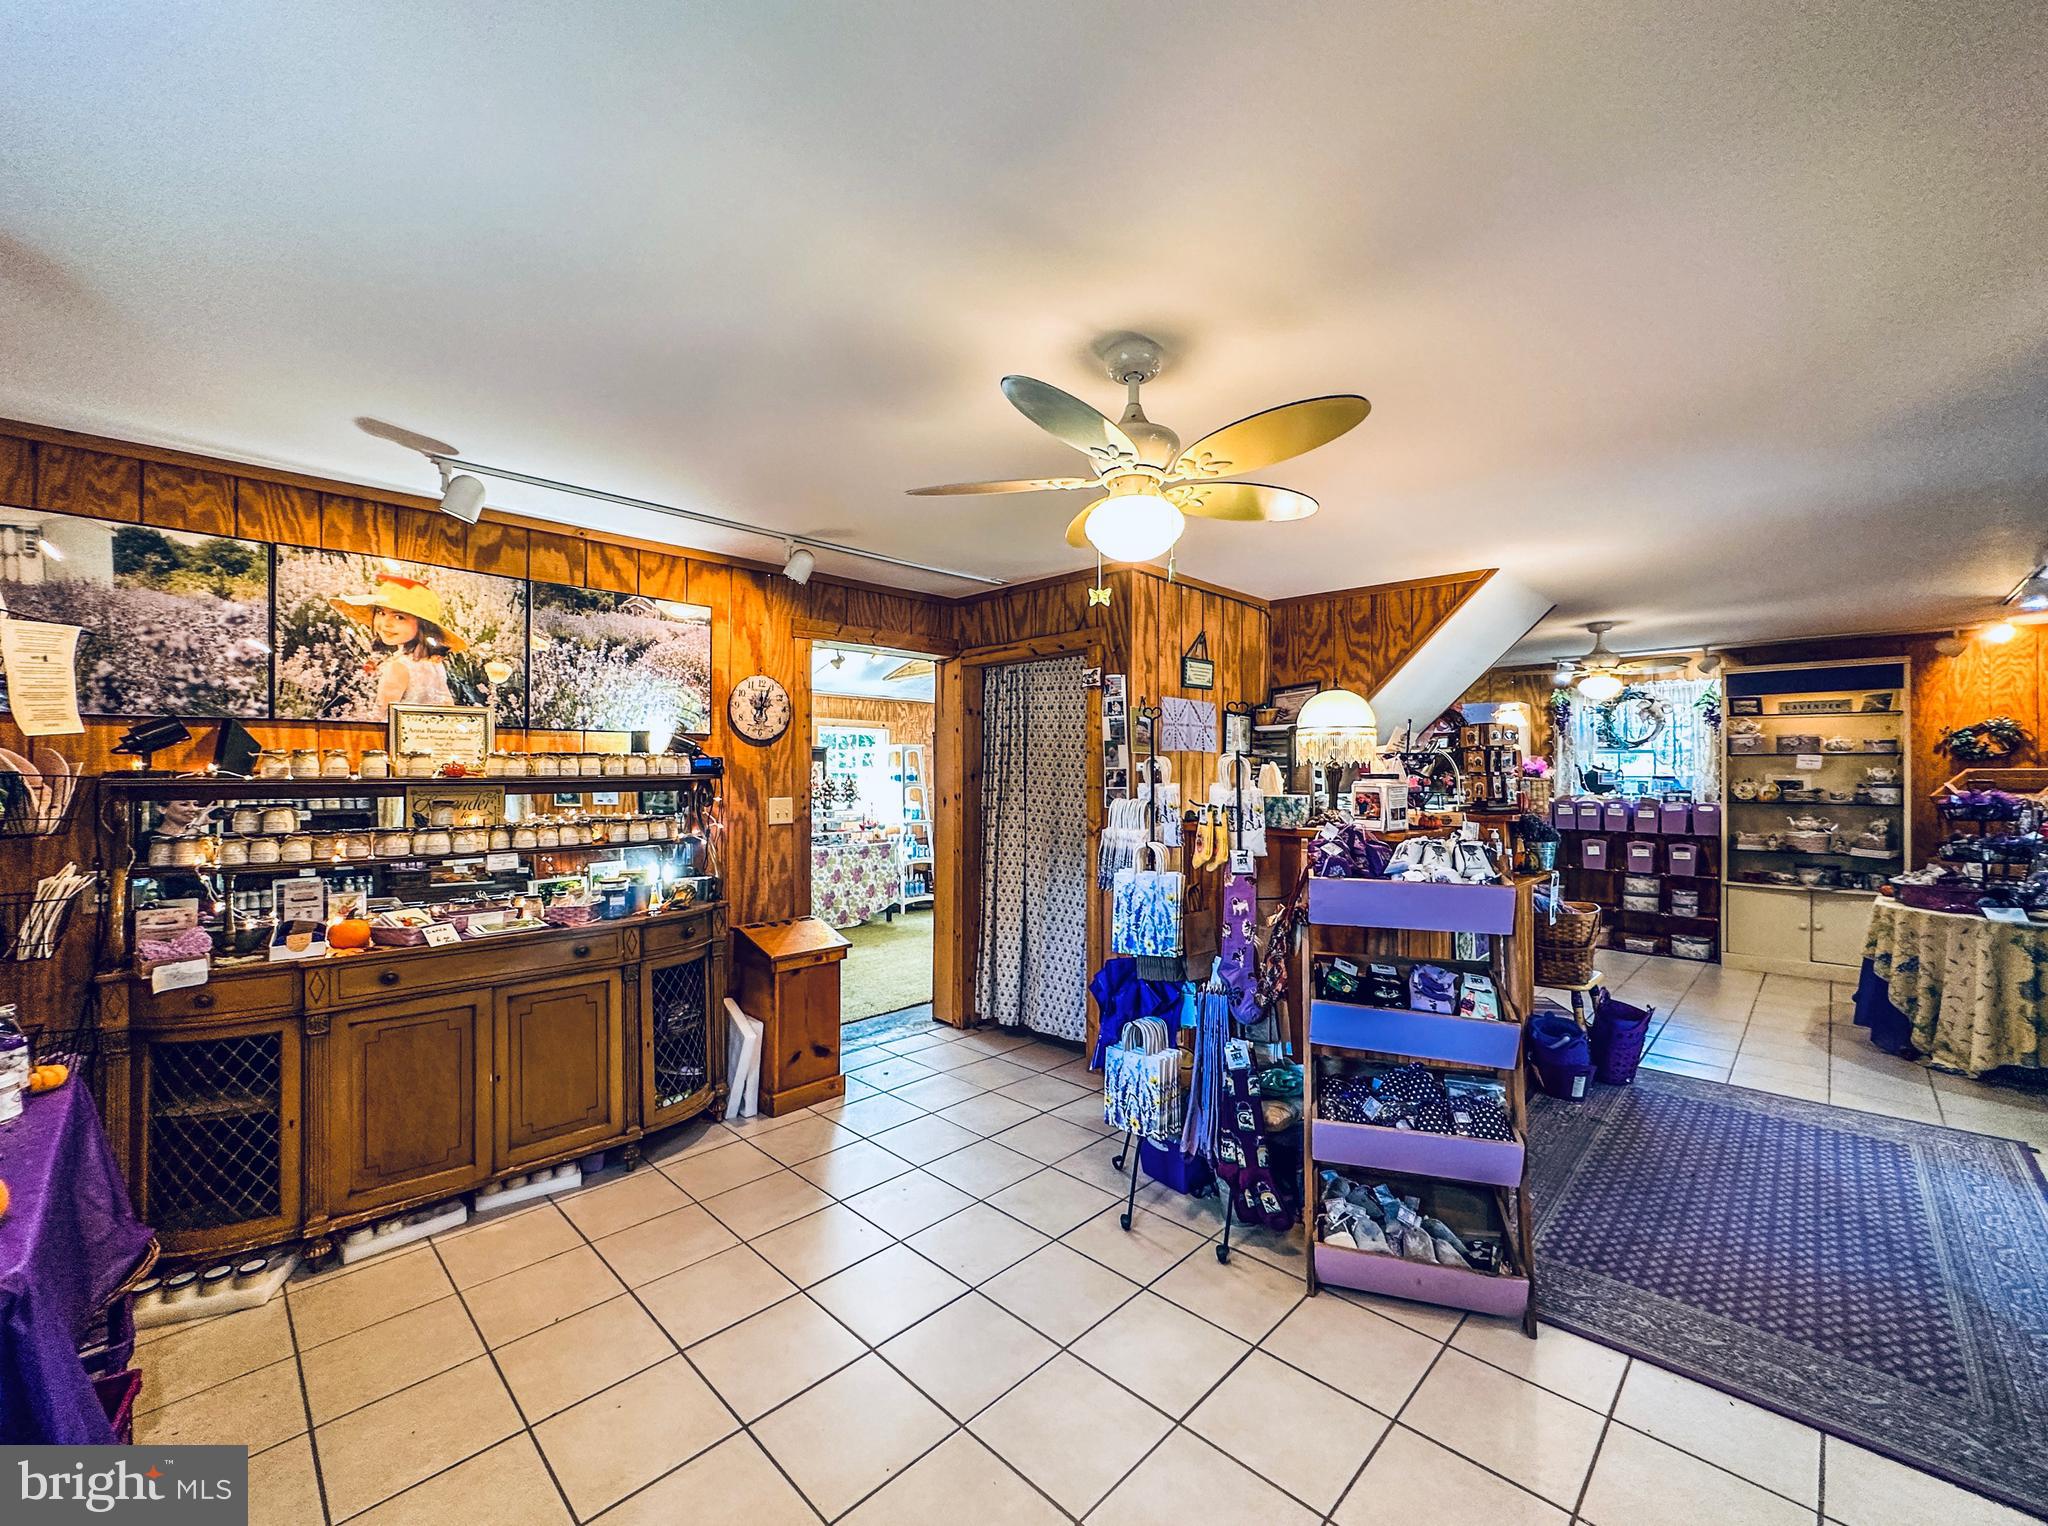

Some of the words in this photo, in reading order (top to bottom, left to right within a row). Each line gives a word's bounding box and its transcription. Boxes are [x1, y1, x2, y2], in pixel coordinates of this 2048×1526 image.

[747, 681, 754, 689] 11
[758, 679, 767, 687] 12
[738, 689, 746, 697] 10
[1785, 703, 1841, 711] LAVENDER
